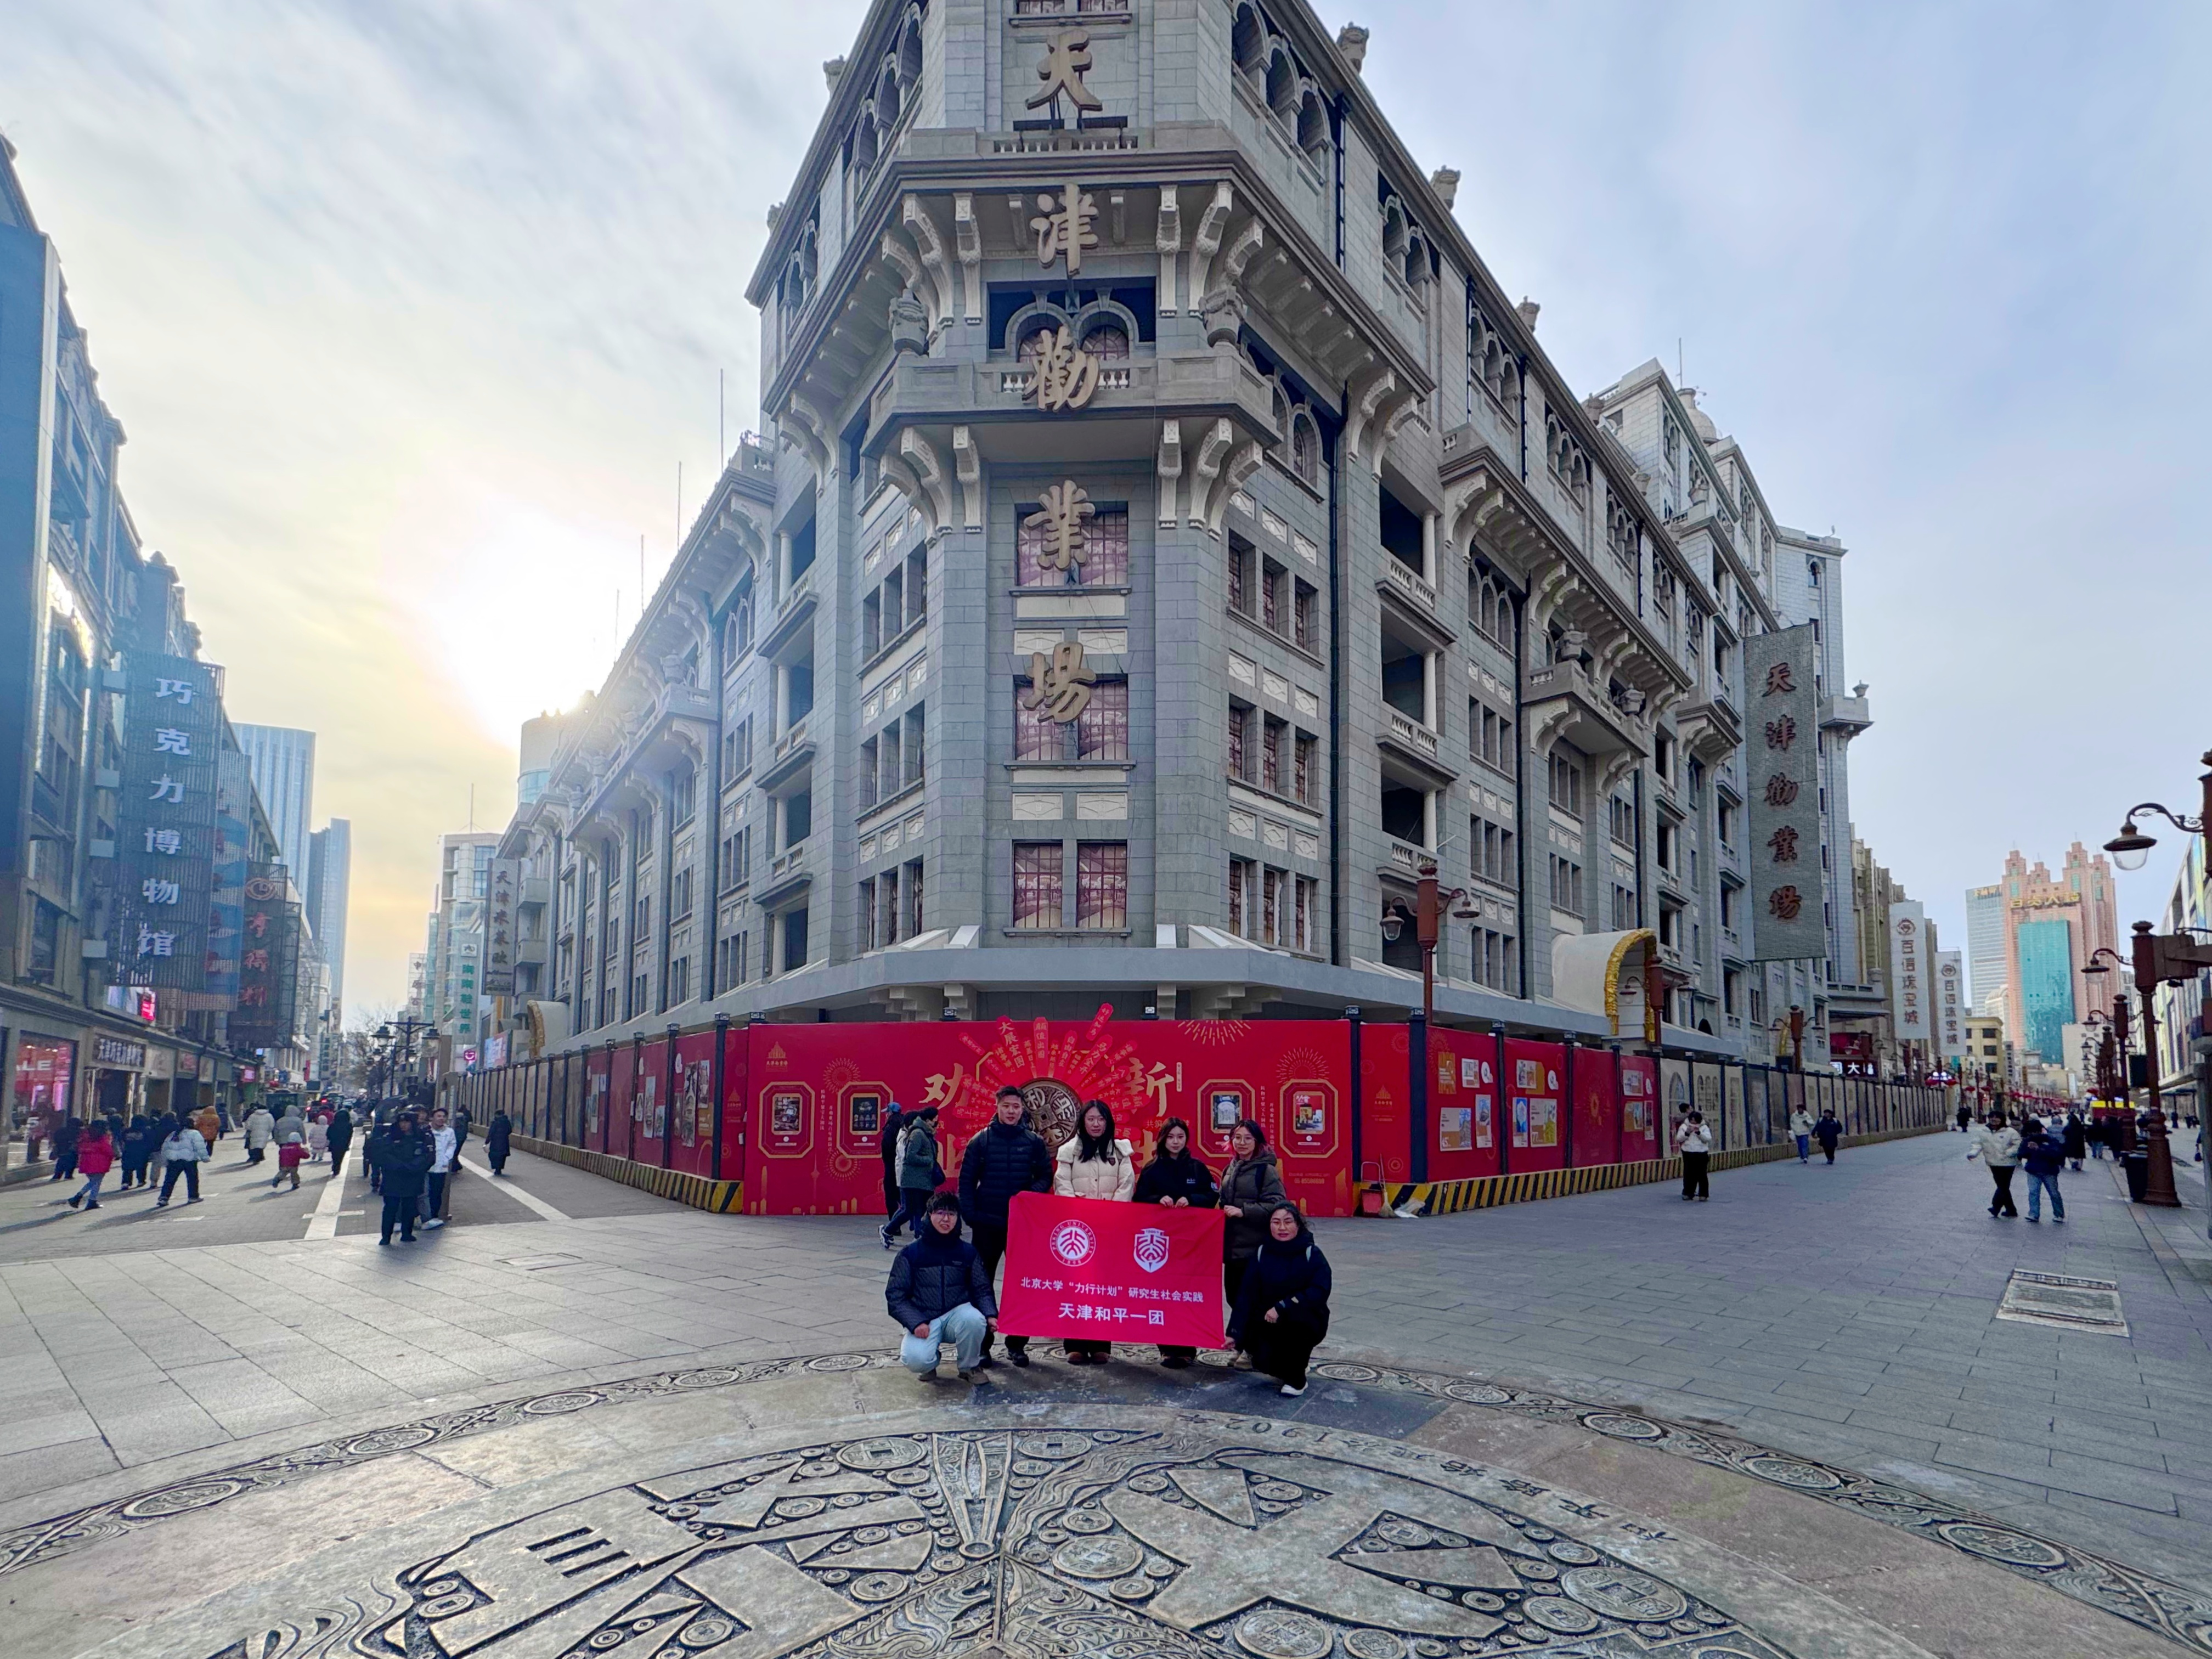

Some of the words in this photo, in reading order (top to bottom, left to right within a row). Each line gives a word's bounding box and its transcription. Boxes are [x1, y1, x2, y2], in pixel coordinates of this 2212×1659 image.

[137, 677, 193, 957] 巧克力博物馆
[1901, 939, 1918, 1025] 百信珠宝城
[16, 1060, 52, 1071] LE
[919, 1063, 970, 1110] 劝
[1051, 1223, 1065, 1251] PEKING
[1066, 1221, 1093, 1254] UNIVERSITY
[1021, 1277, 1063, 1291] 北京大学
[1069, 1282, 1123, 1297] “力行计划”
[1128, 1287, 1204, 1303] 研究生社会实践
[1058, 1302, 1165, 1326] 天津和平一团
